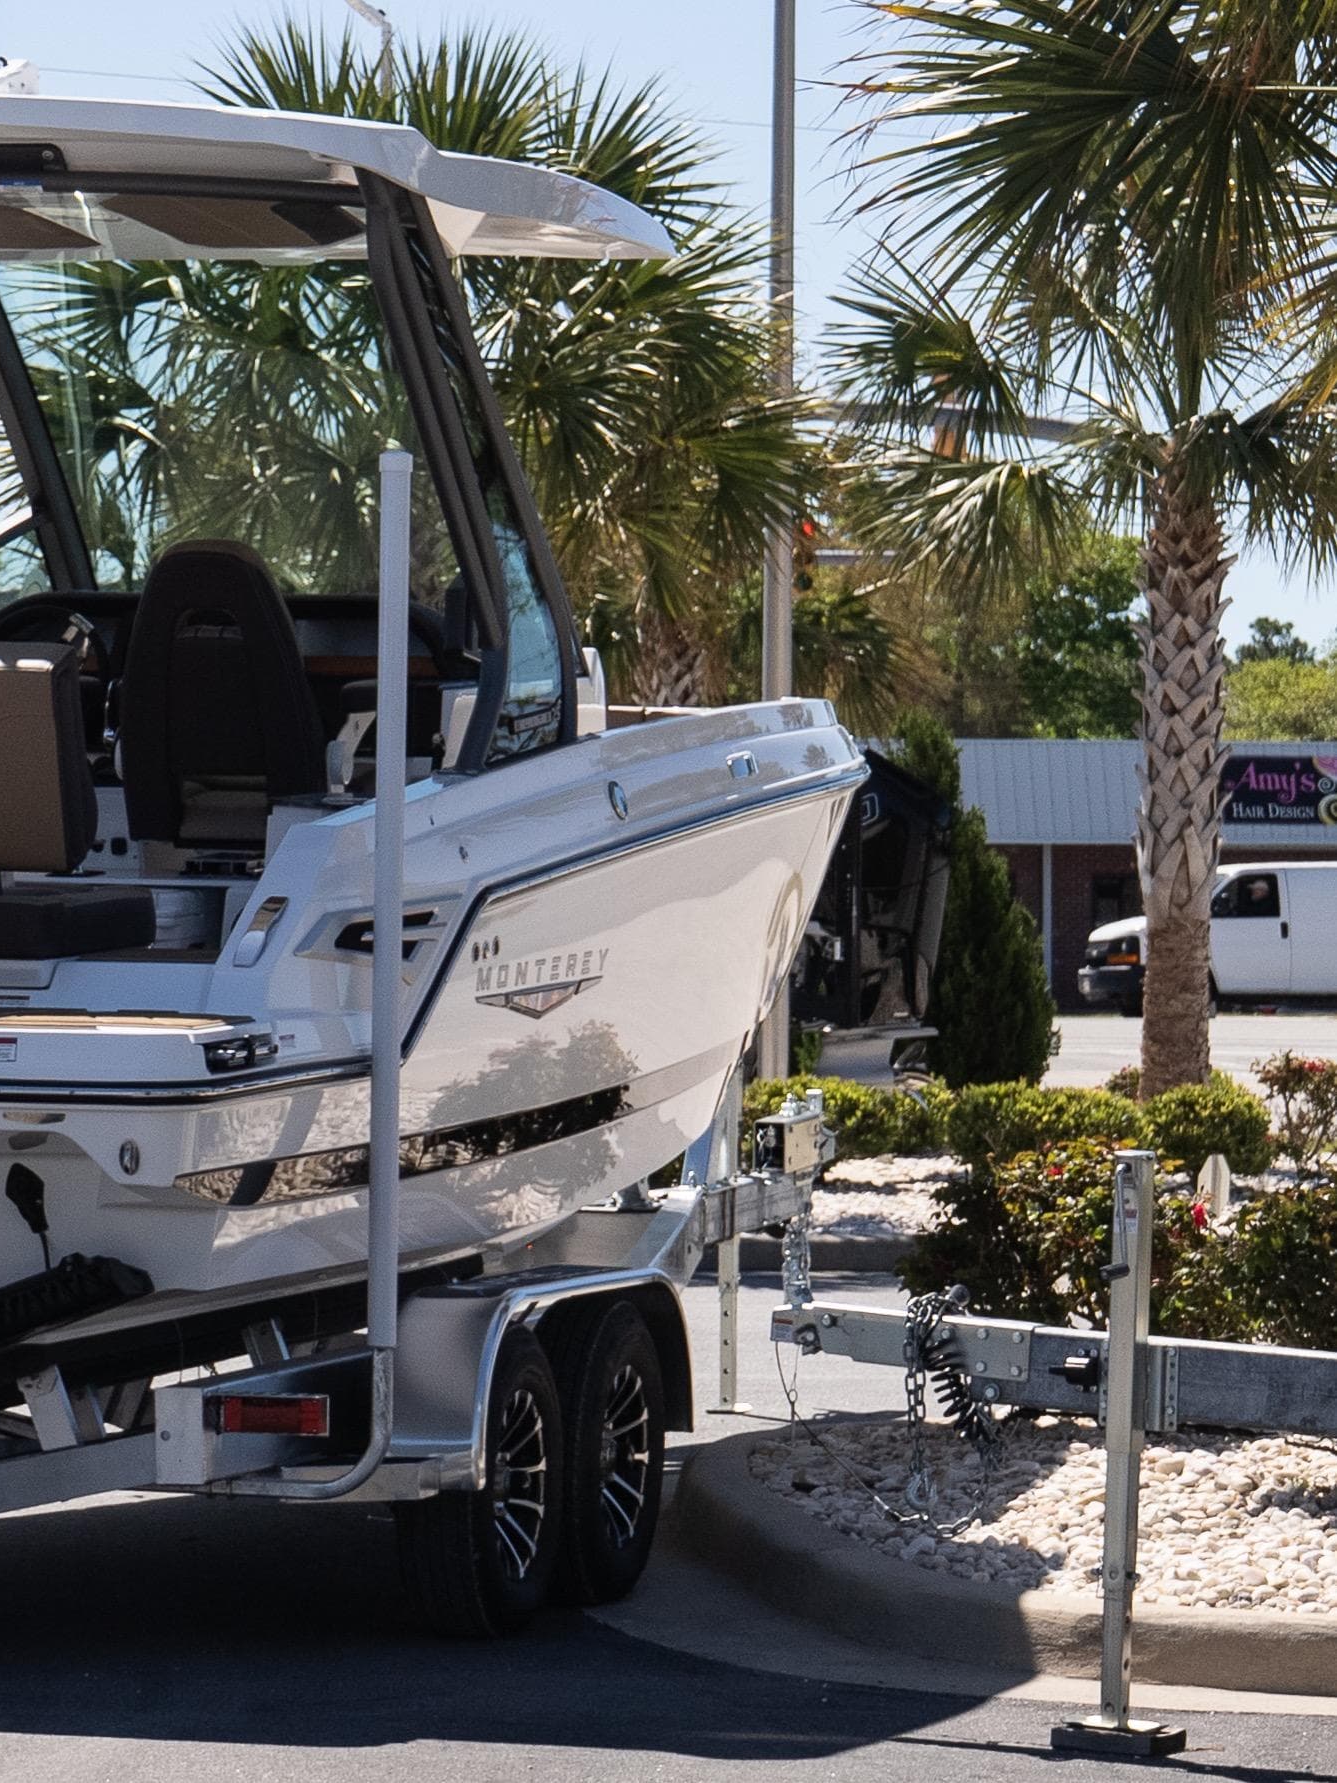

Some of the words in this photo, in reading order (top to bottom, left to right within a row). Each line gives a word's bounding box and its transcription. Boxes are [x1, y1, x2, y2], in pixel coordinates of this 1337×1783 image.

[1233, 761, 1316, 804] Amy's
[1232, 802, 1264, 818] HAIR
[1269, 802, 1315, 818] DESIGN
[475, 948, 609, 991] MONTEREY
